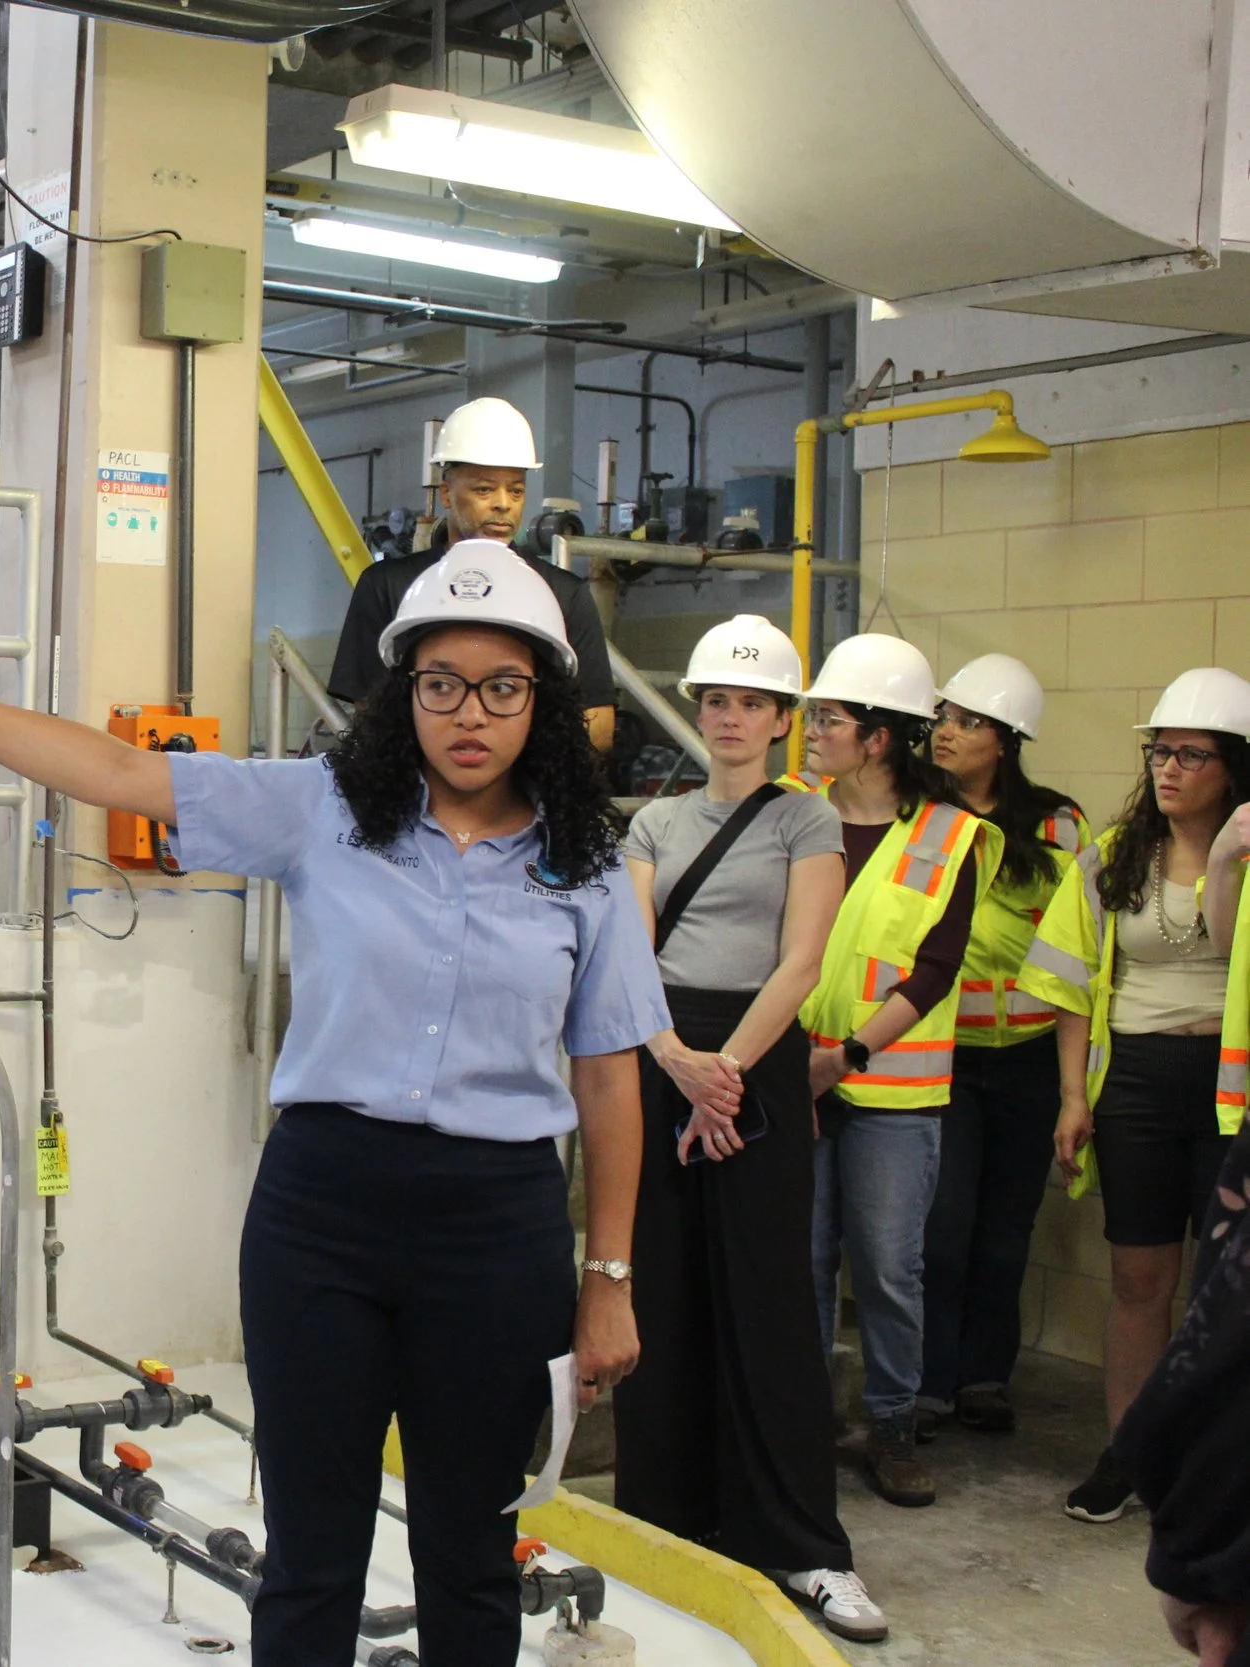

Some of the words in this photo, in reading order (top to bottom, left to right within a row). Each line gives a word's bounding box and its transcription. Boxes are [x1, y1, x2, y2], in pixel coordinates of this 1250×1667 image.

[27, 181, 68, 207] CAUTION
[50, 210, 64, 221] MAY
[34, 234, 44, 245] BE
[109, 451, 141, 467] PACL
[113, 472, 141, 482] HEALTH
[113, 483, 167, 497] FLAMMABILITY
[732, 646, 759, 661] HDR
[524, 881, 571, 901] UTILITIES
[38, 1140, 57, 1148] CAUTI
[41, 1151, 58, 1162] MAI
